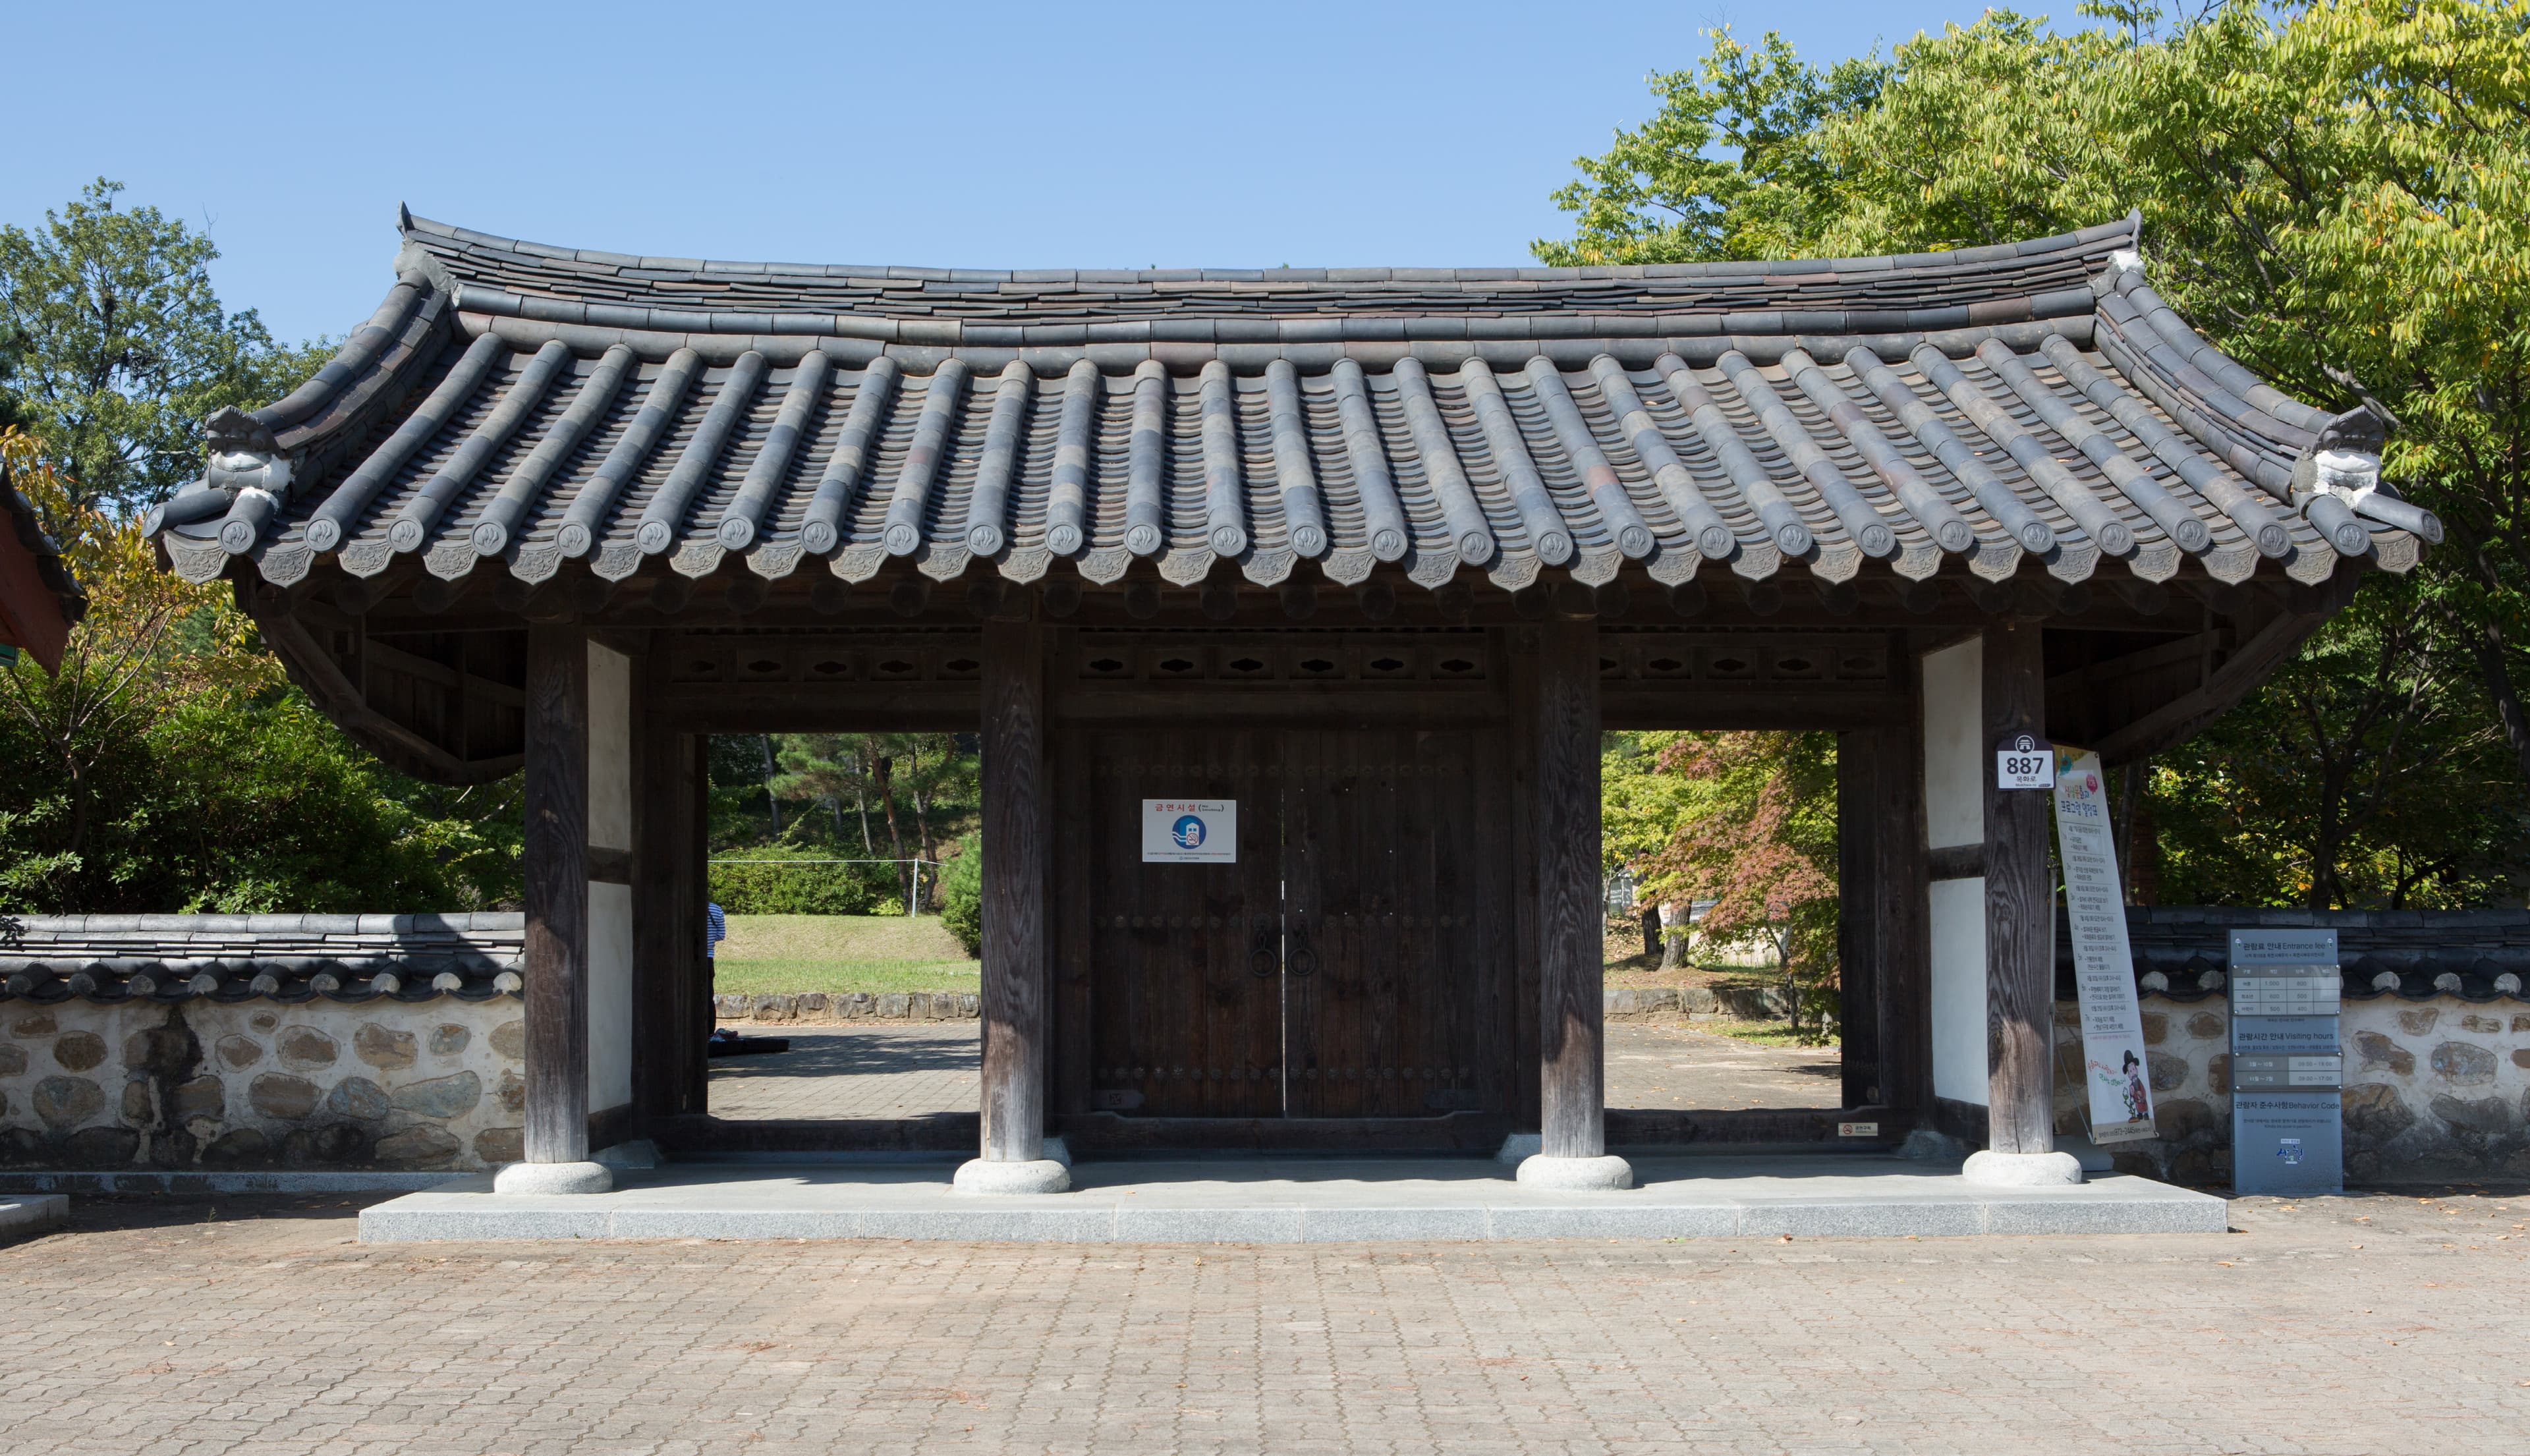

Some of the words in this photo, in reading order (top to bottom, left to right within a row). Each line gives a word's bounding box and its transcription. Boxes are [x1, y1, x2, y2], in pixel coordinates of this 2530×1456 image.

[2007, 757, 2044, 775] 887
[1154, 804, 1196, 812] 금연시설
[2238, 1032, 2268, 1041] 관람시간
[2270, 1032, 2284, 1041] 안내
[2235, 1101, 2257, 1109] 관람자
[2259, 1101, 2289, 1109] 준수사항
